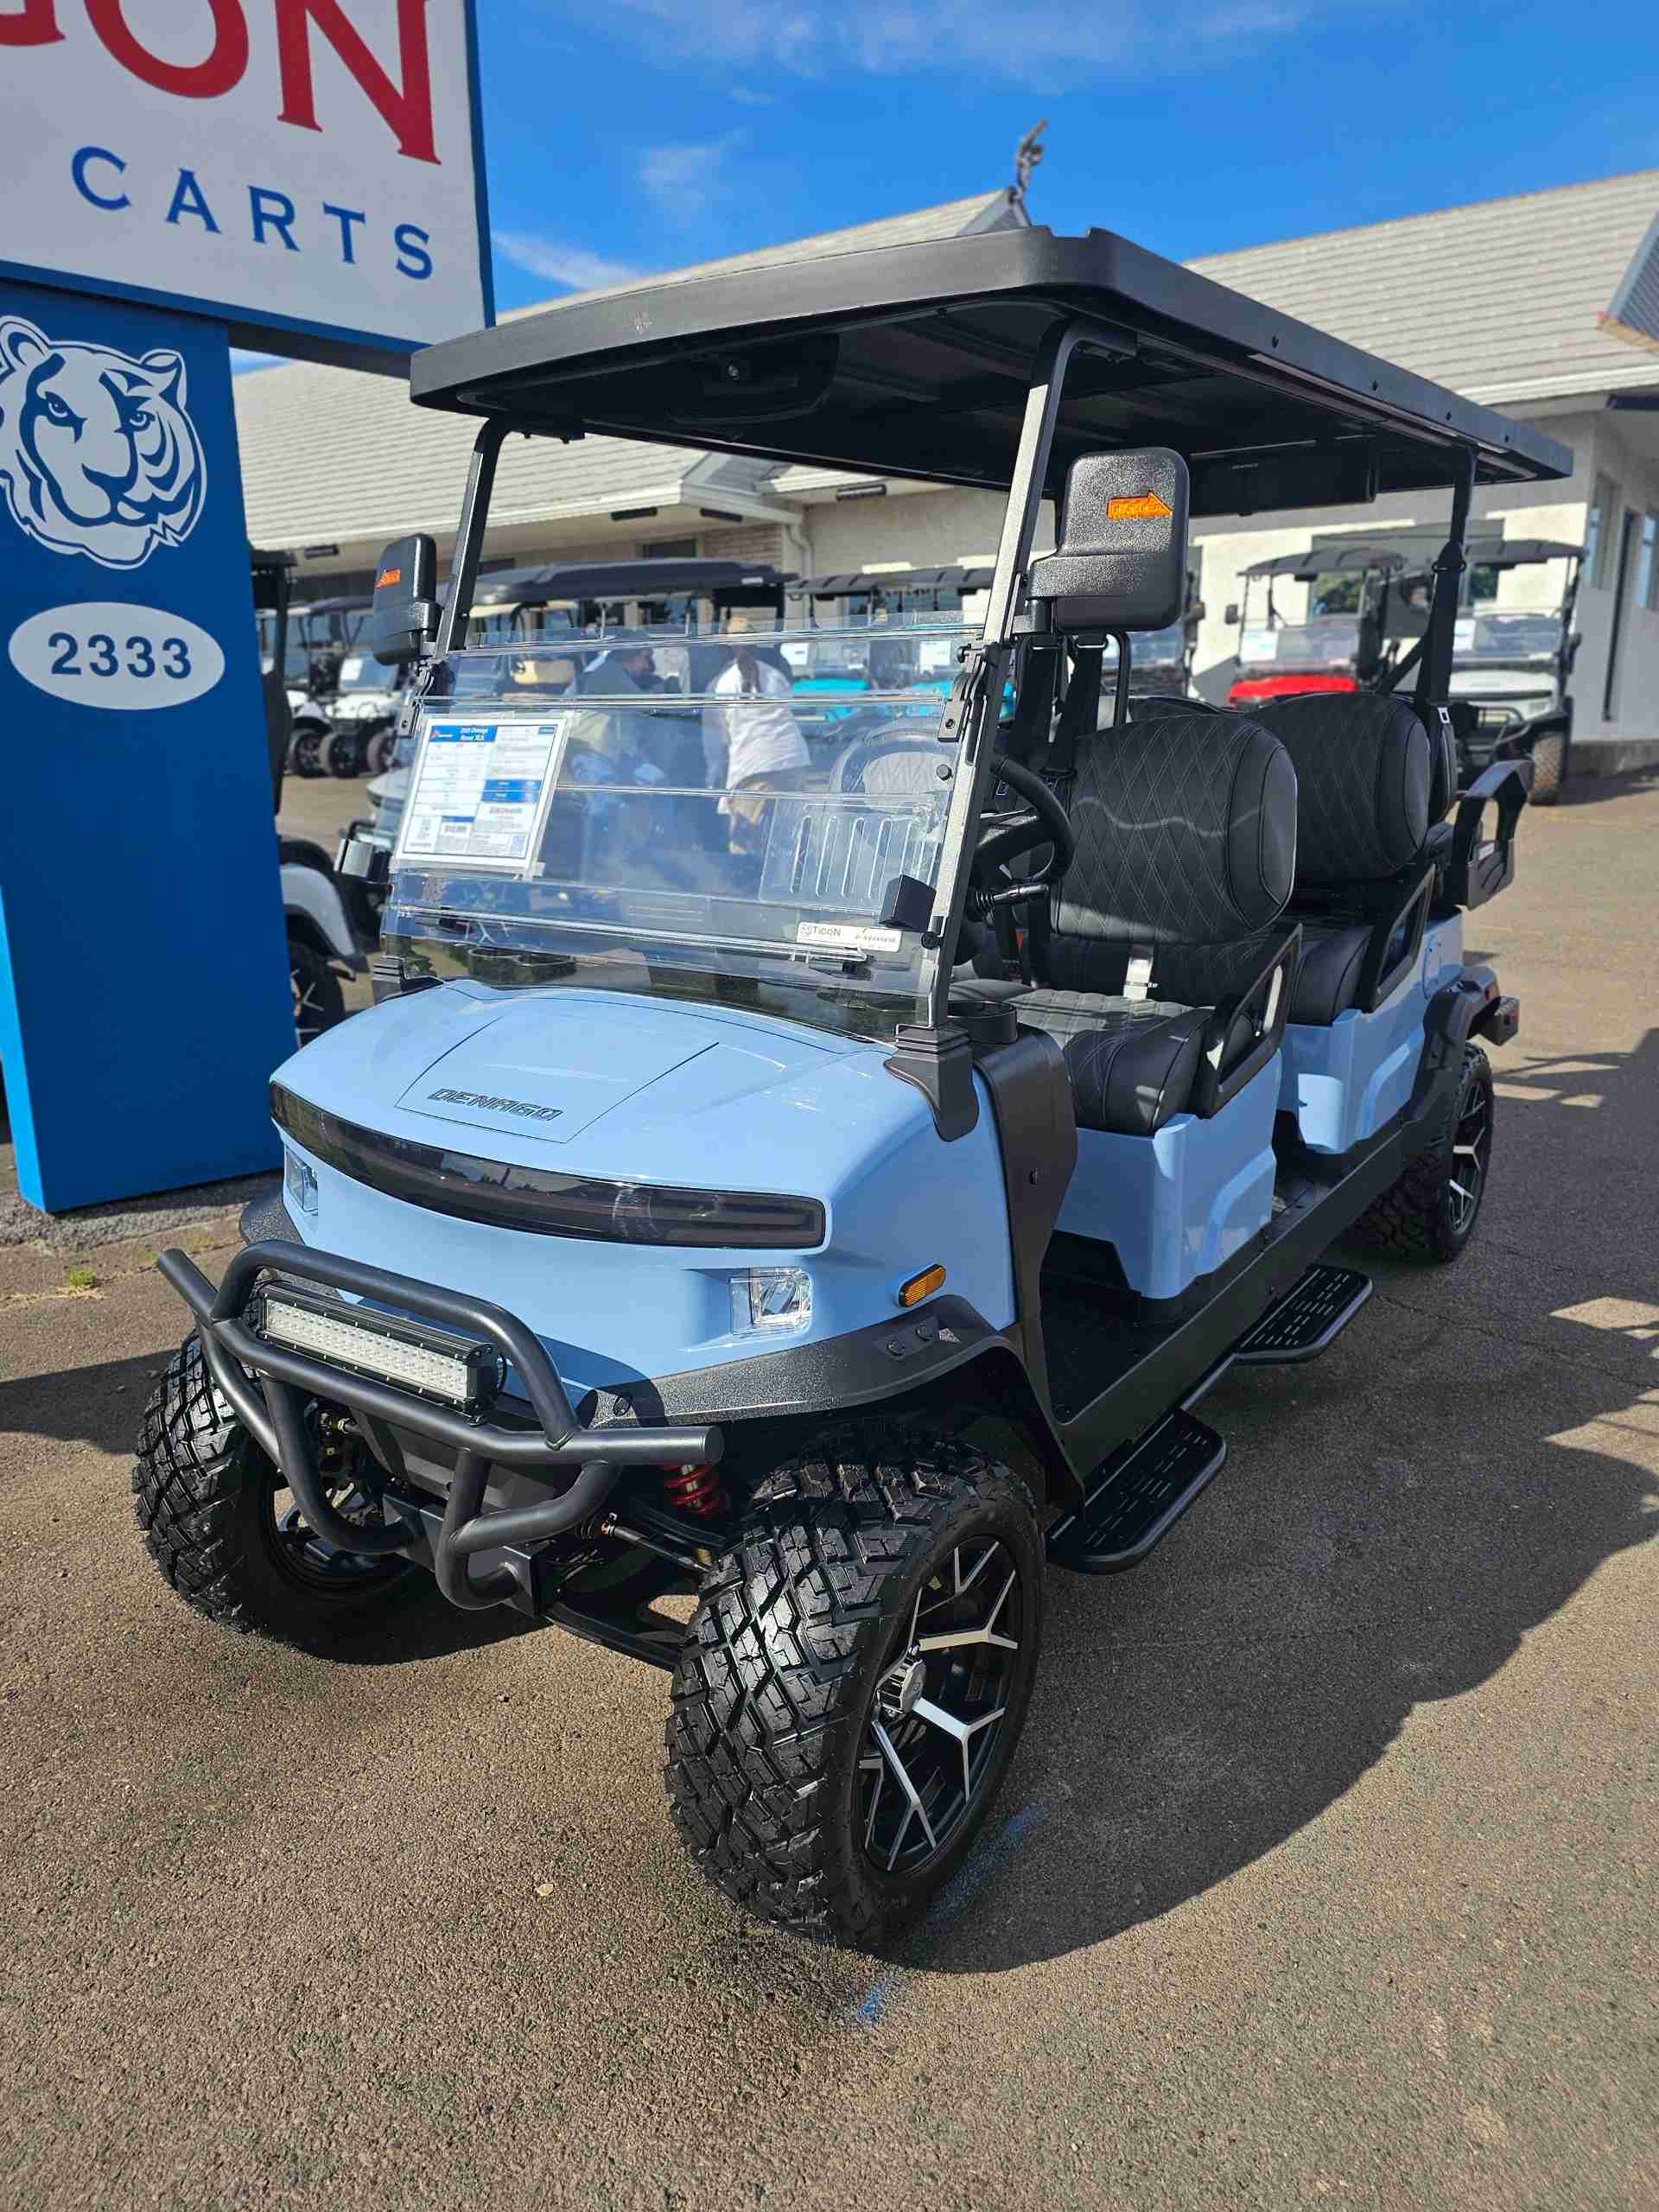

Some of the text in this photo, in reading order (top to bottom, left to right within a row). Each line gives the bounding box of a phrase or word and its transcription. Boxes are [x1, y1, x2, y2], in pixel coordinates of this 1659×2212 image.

[71, 146, 433, 280] CARTS
[48, 632, 191, 679] 2333
[427, 1088, 563, 1121] DENAGO
